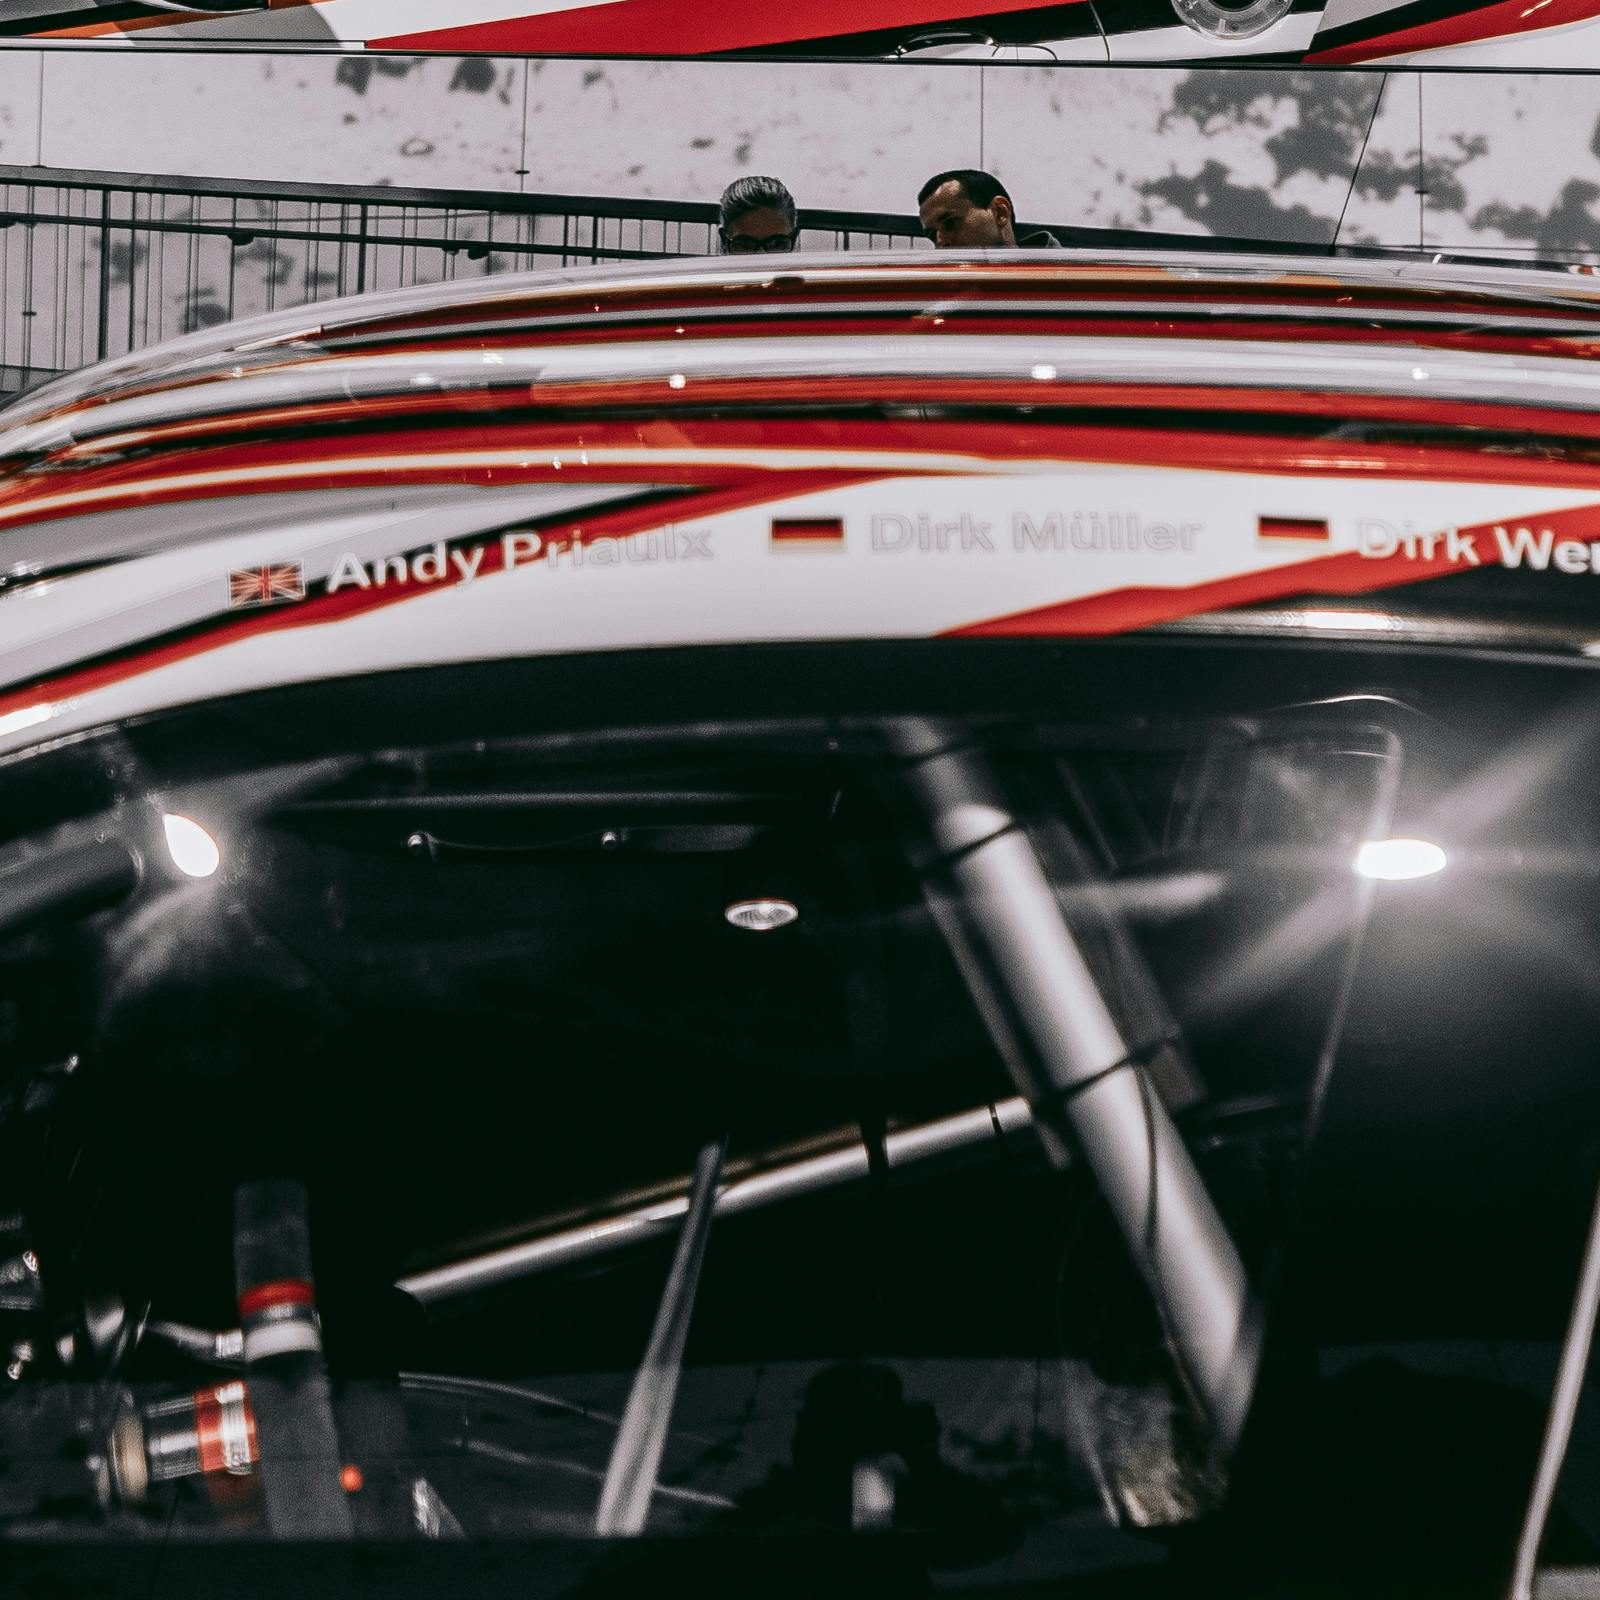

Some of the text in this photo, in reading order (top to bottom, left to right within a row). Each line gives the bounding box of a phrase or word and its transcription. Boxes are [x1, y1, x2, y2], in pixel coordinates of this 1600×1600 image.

[325, 523, 714, 590] Andy Priaulx
[869, 509, 1203, 553] Dirk Müller
[1356, 515, 1481, 566] Dirk
